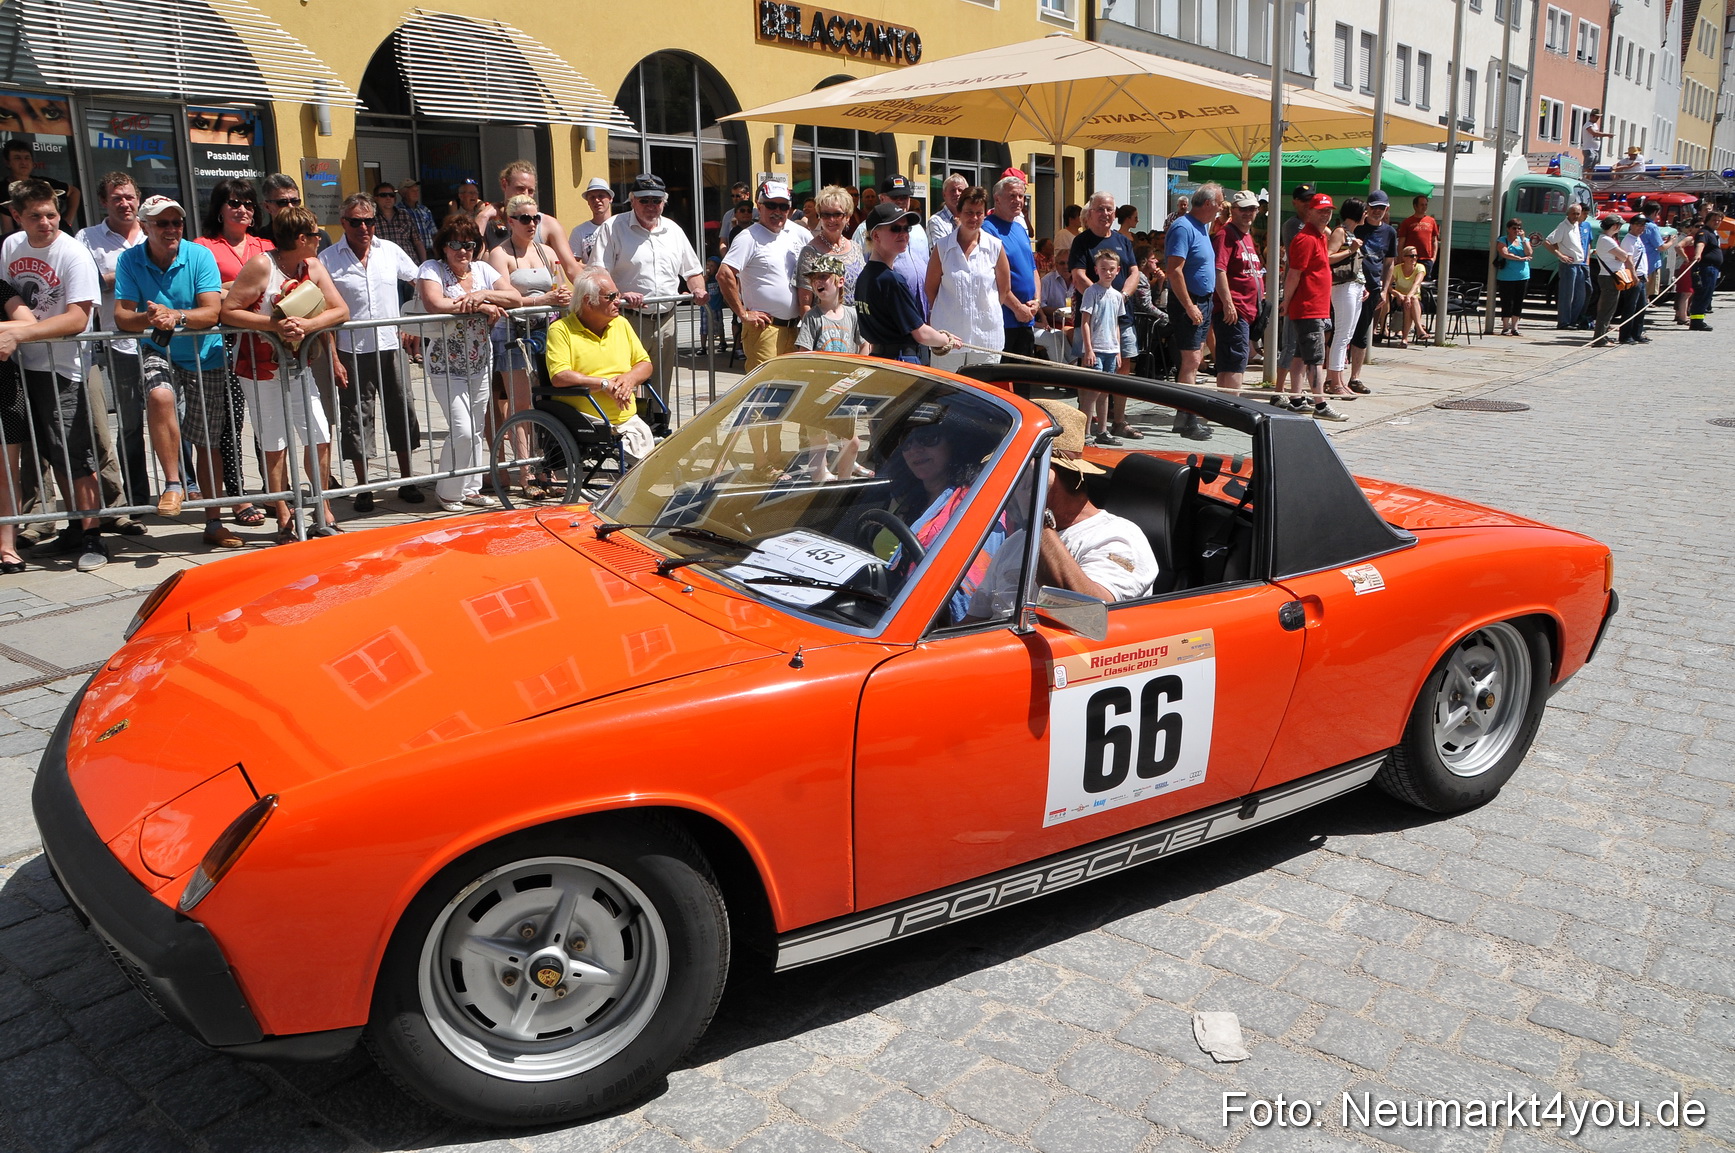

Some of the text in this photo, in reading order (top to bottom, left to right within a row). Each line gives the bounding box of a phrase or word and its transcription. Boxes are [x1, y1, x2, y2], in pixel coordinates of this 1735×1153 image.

[760, 1, 922, 61] BELACCANTO
[32, 141, 63, 153] Bilder
[206, 151, 250, 161] Passbilder
[194, 167, 266, 179] Bewerbungsbilder
[1076, 170, 1085, 182] 24
[805, 548, 846, 565] 452
[1091, 645, 1169, 669] Riedenburg
[1104, 658, 1158, 677] Classic 2013
[1083, 674, 1183, 794] 66
[897, 823, 1207, 937] PORSCHE
